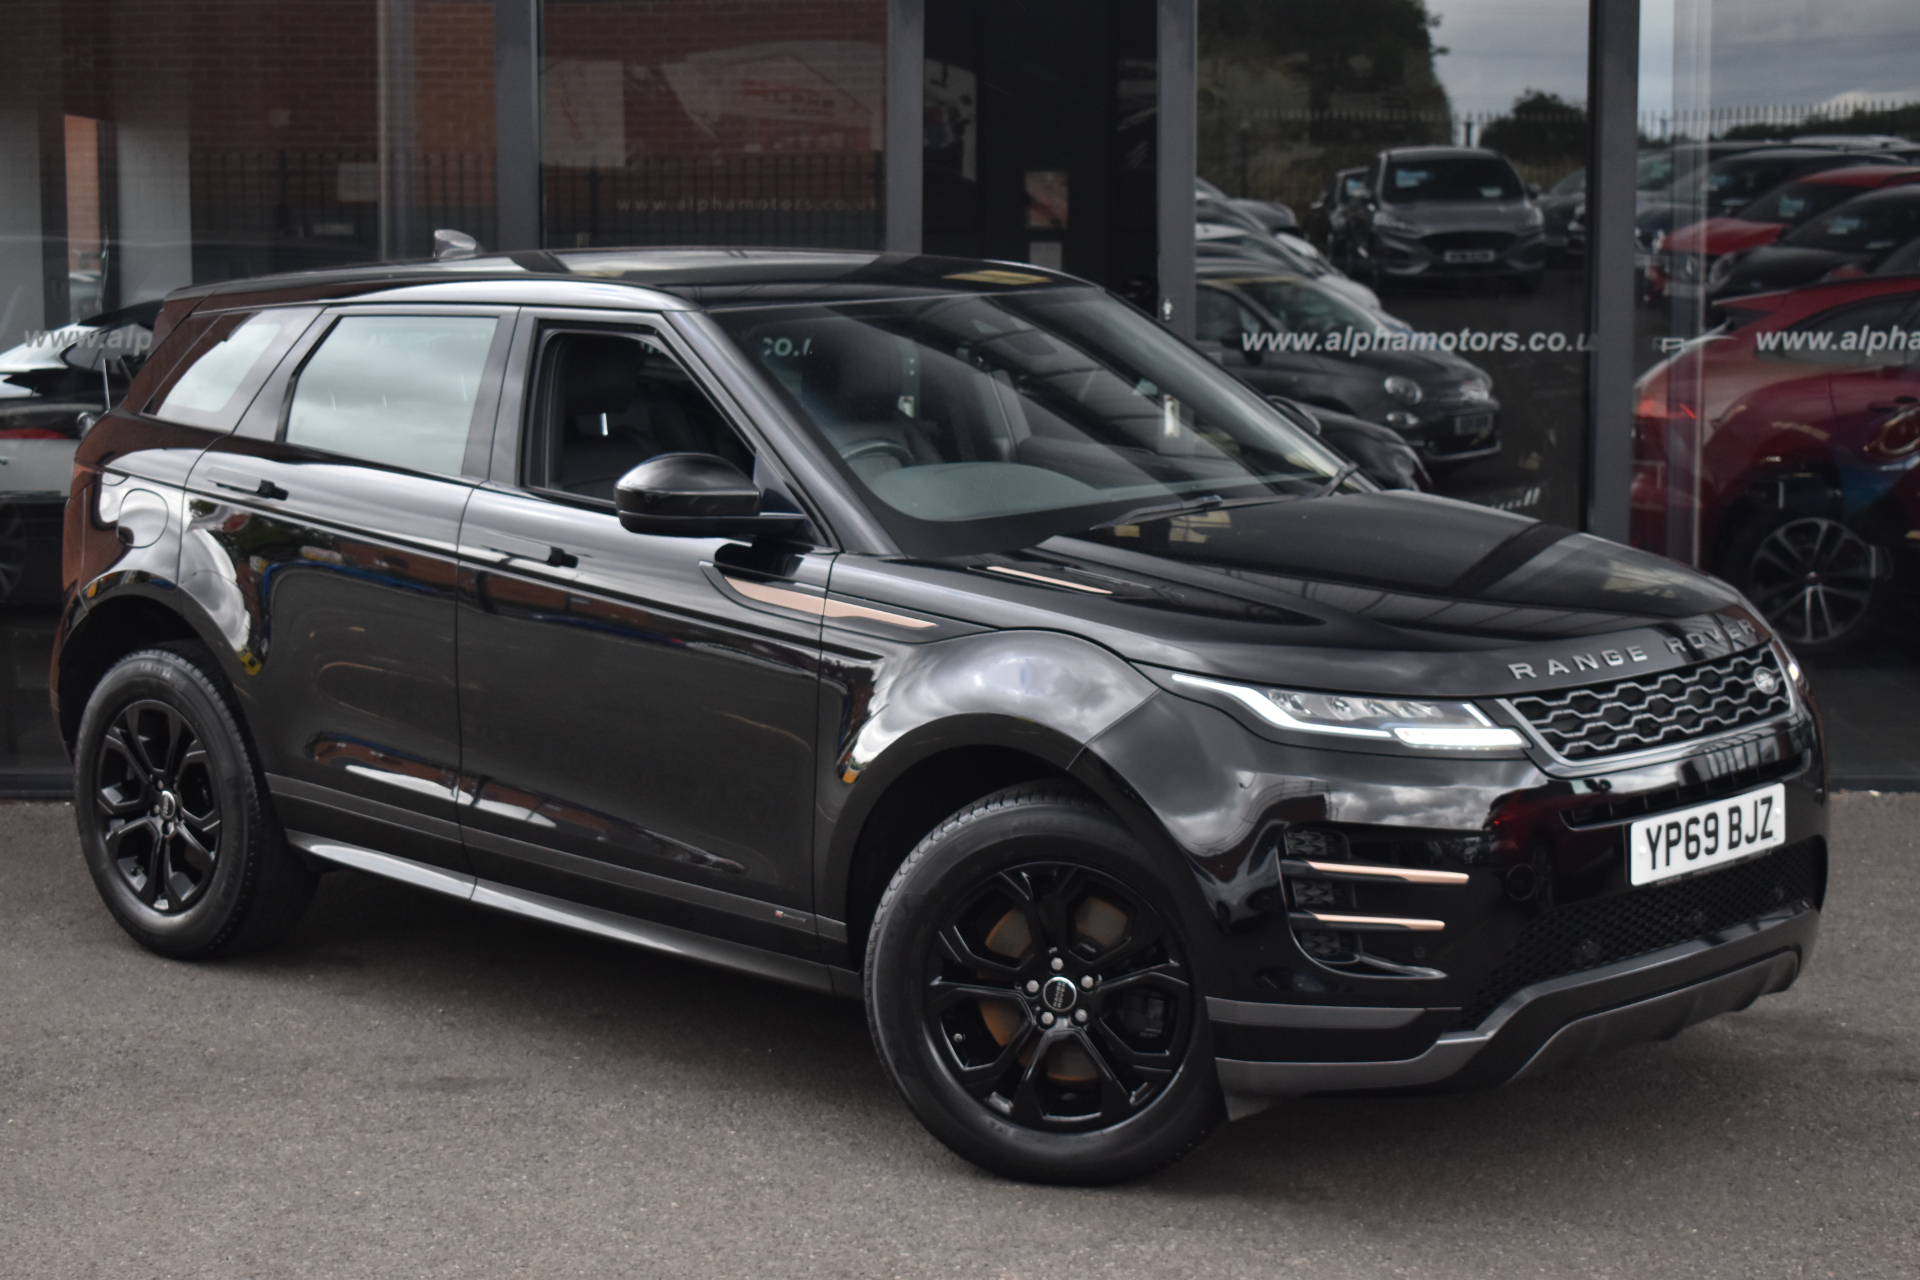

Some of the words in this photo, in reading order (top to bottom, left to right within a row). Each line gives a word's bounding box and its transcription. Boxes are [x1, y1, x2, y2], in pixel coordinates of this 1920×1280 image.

[1755, 324, 1920, 357] www.alpha
[1507, 645, 1648, 680] RANGE
[1663, 618, 1756, 655] ROVER
[1645, 811, 1719, 870] YP69
[1727, 795, 1774, 850] BJZ
